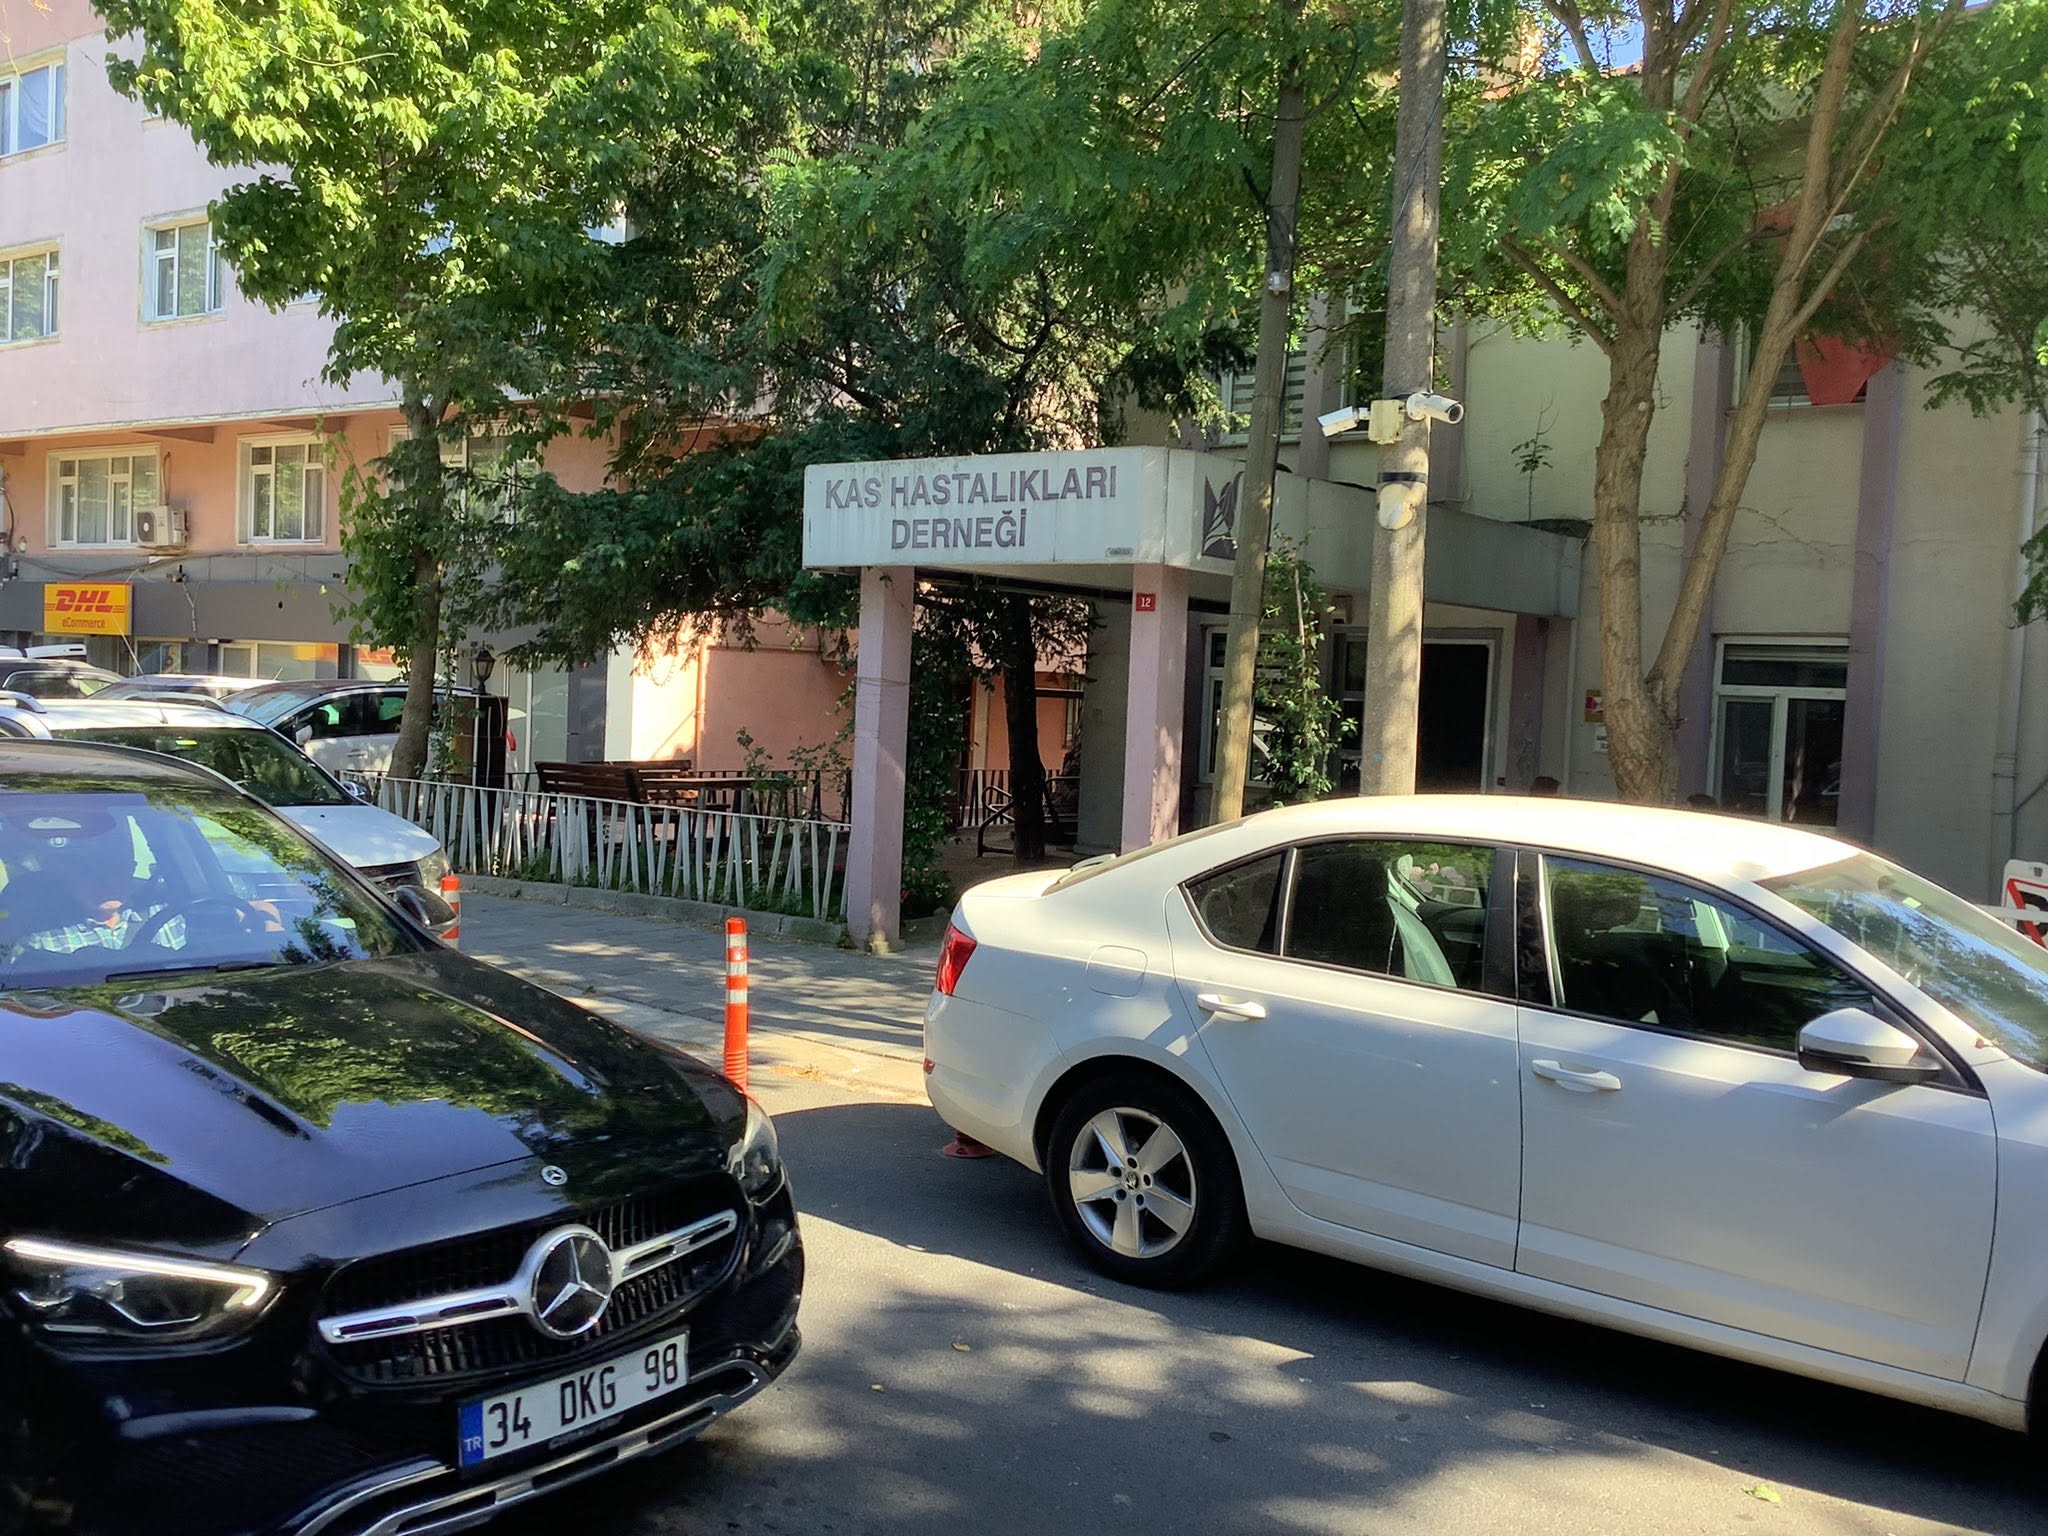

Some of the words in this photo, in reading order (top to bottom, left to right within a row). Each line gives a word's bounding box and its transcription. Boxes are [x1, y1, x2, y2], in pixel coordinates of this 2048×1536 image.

[825, 477, 882, 509] KAS
[890, 466, 1118, 507] HASTALIKLARI
[890, 509, 1028, 550] DERNEĞİ
[55, 589, 113, 613] DHL
[1140, 596, 1152, 608] 12
[62, 617, 106, 629] eCommerce
[488, 1397, 531, 1449] 34
[560, 1366, 616, 1426] DKG
[644, 1342, 679, 1392] 98
[463, 1437, 482, 1452] TR
